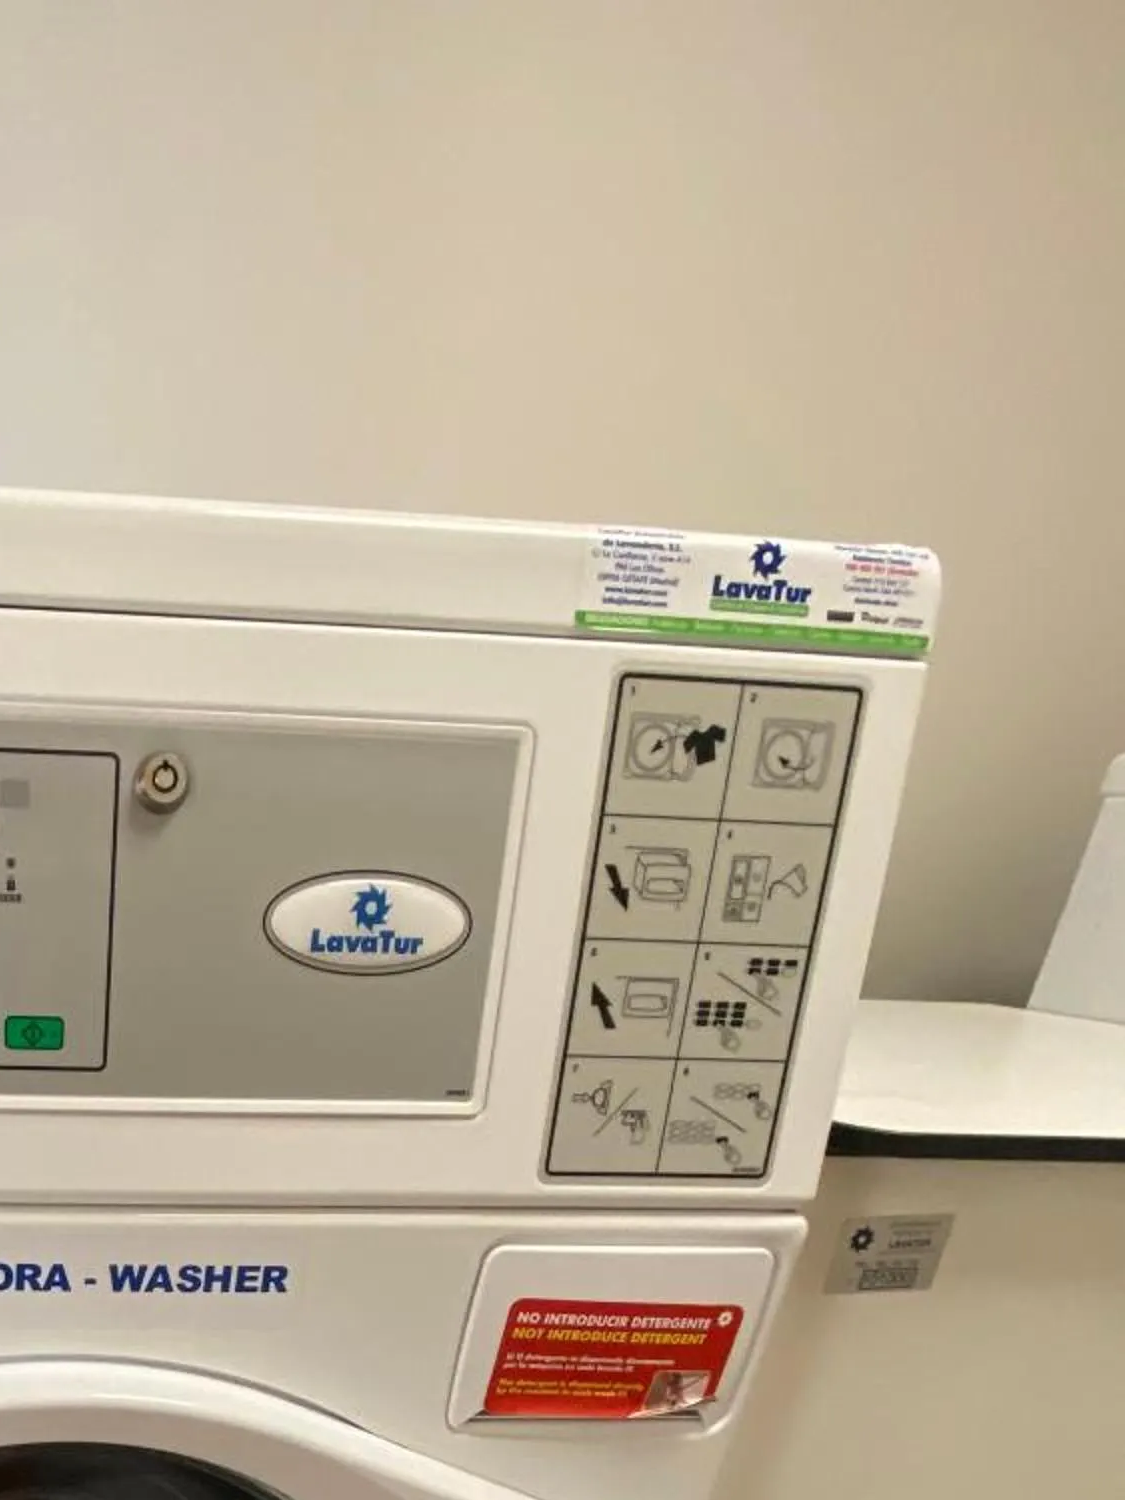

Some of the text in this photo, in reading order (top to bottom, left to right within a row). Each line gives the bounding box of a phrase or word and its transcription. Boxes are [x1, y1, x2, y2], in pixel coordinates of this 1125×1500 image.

[713, 574, 812, 602] LavaTur
[310, 927, 423, 954] LavaTur
[108, 1263, 289, 1293] WASHER
[517, 1311, 711, 1330] NO INTRODUCIR DETERGENTE
[512, 1327, 707, 1345] NOT INTRODUCE DETERGENT
